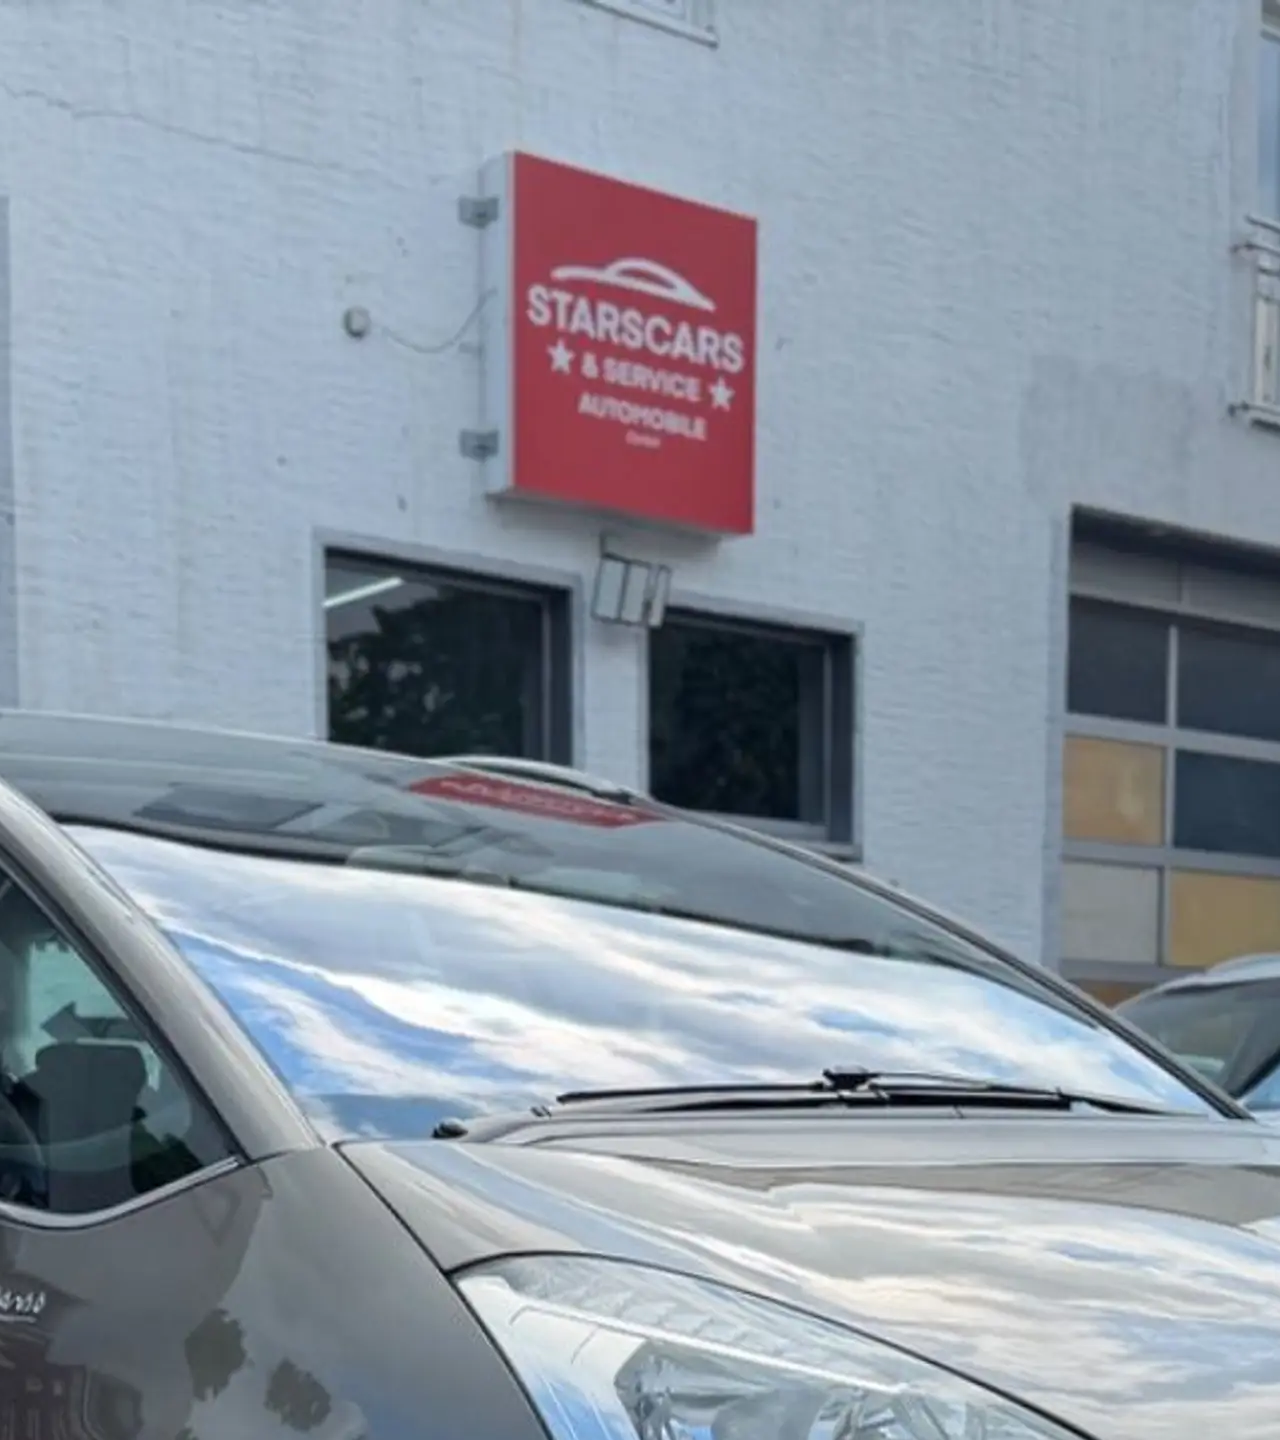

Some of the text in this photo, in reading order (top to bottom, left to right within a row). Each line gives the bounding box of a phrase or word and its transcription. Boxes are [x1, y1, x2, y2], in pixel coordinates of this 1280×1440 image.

[526, 284, 744, 373] STARSCARS
[581, 352, 701, 402] & SERVICE
[578, 391, 707, 441] AUTOMOBILE
